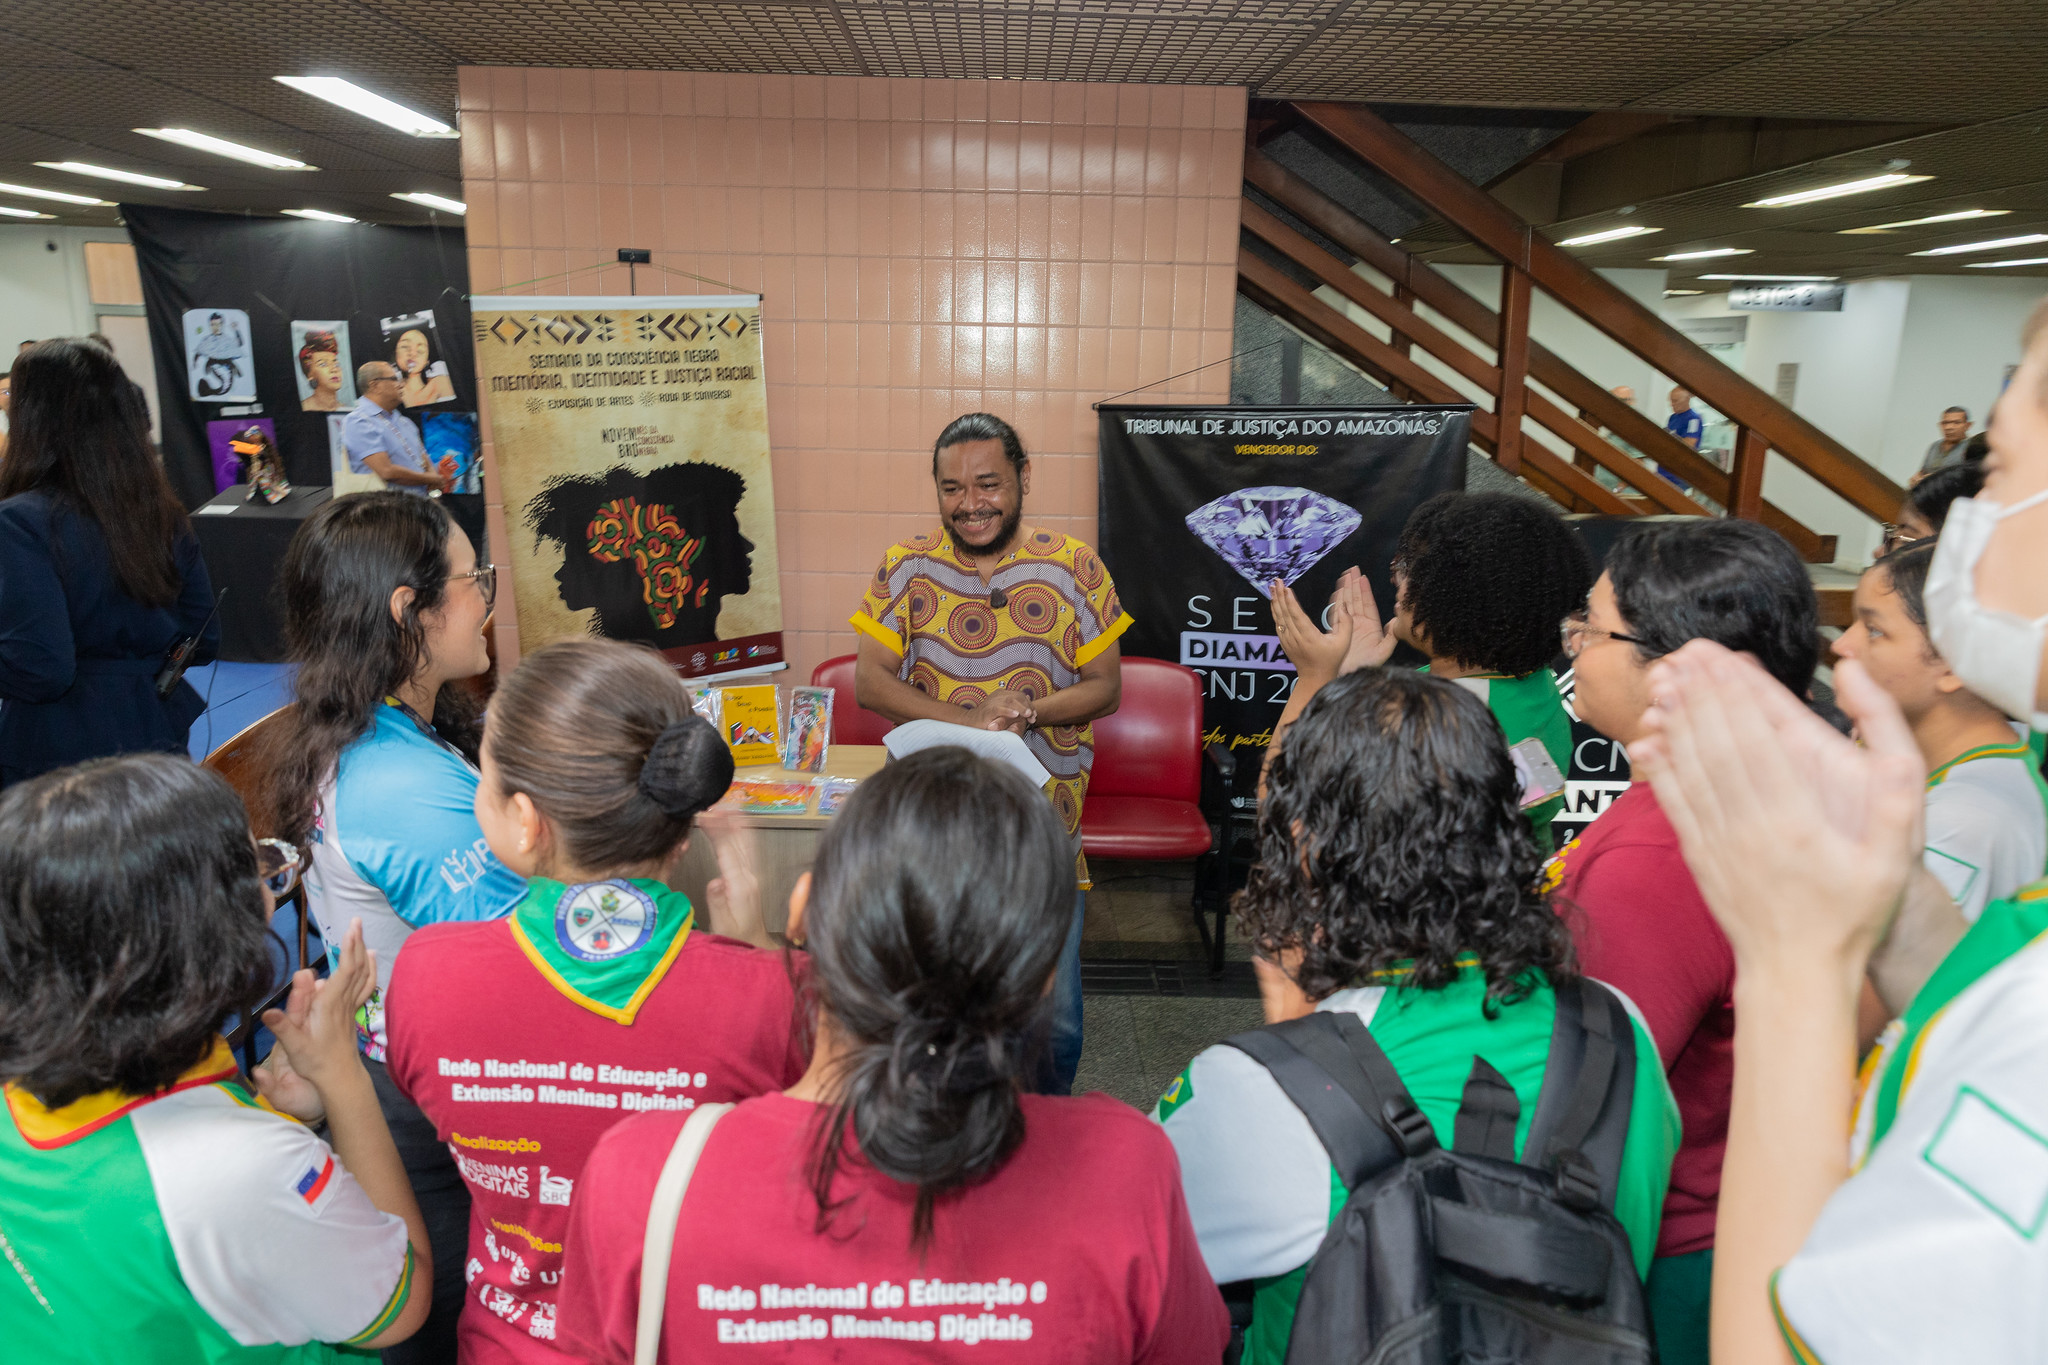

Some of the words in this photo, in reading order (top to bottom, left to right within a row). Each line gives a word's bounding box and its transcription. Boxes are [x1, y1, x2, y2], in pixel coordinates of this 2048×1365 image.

[529, 353, 582, 369] SEMANA
[587, 352, 602, 367] DA
[606, 348, 680, 366] CONSCIÊNCIA
[684, 349, 720, 363] NEGRA
[491, 370, 568, 392] MEMÓRIA,
[571, 370, 647, 388] IDENTIDADE
[650, 369, 658, 385] E
[664, 367, 713, 387] JUSTIÇA
[715, 365, 757, 381] RACIAL
[596, 397, 607, 407] DE
[682, 391, 692, 401] DE
[1125, 419, 1200, 435] TRIBUNAL
[1202, 420, 1226, 436] DE
[1228, 420, 1300, 440] JUSTIÇA
[1302, 419, 1332, 436] DO
[1234, 444, 1296, 456] VENCEDOR
[1189, 638, 1293, 664] DIAMA
[438, 1057, 481, 1077] Rede
[483, 1058, 567, 1080] Nacional
[569, 1062, 594, 1082] de
[597, 1064, 691, 1091] Educação
[693, 1071, 707, 1088] e
[451, 1083, 535, 1103] Extensão
[537, 1084, 618, 1108] Meninas
[621, 1091, 695, 1113] Digitais
[541, 1190, 569, 1203] SBC
[697, 1283, 757, 1311] Rede
[760, 1282, 868, 1309] Nacional
[871, 1281, 905, 1308] de
[908, 1277, 1028, 1311] Educação
[1029, 1280, 1048, 1304] e
[717, 1314, 829, 1343] Extensão
[831, 1314, 936, 1342] Meninas
[938, 1313, 1034, 1345] Digitais
